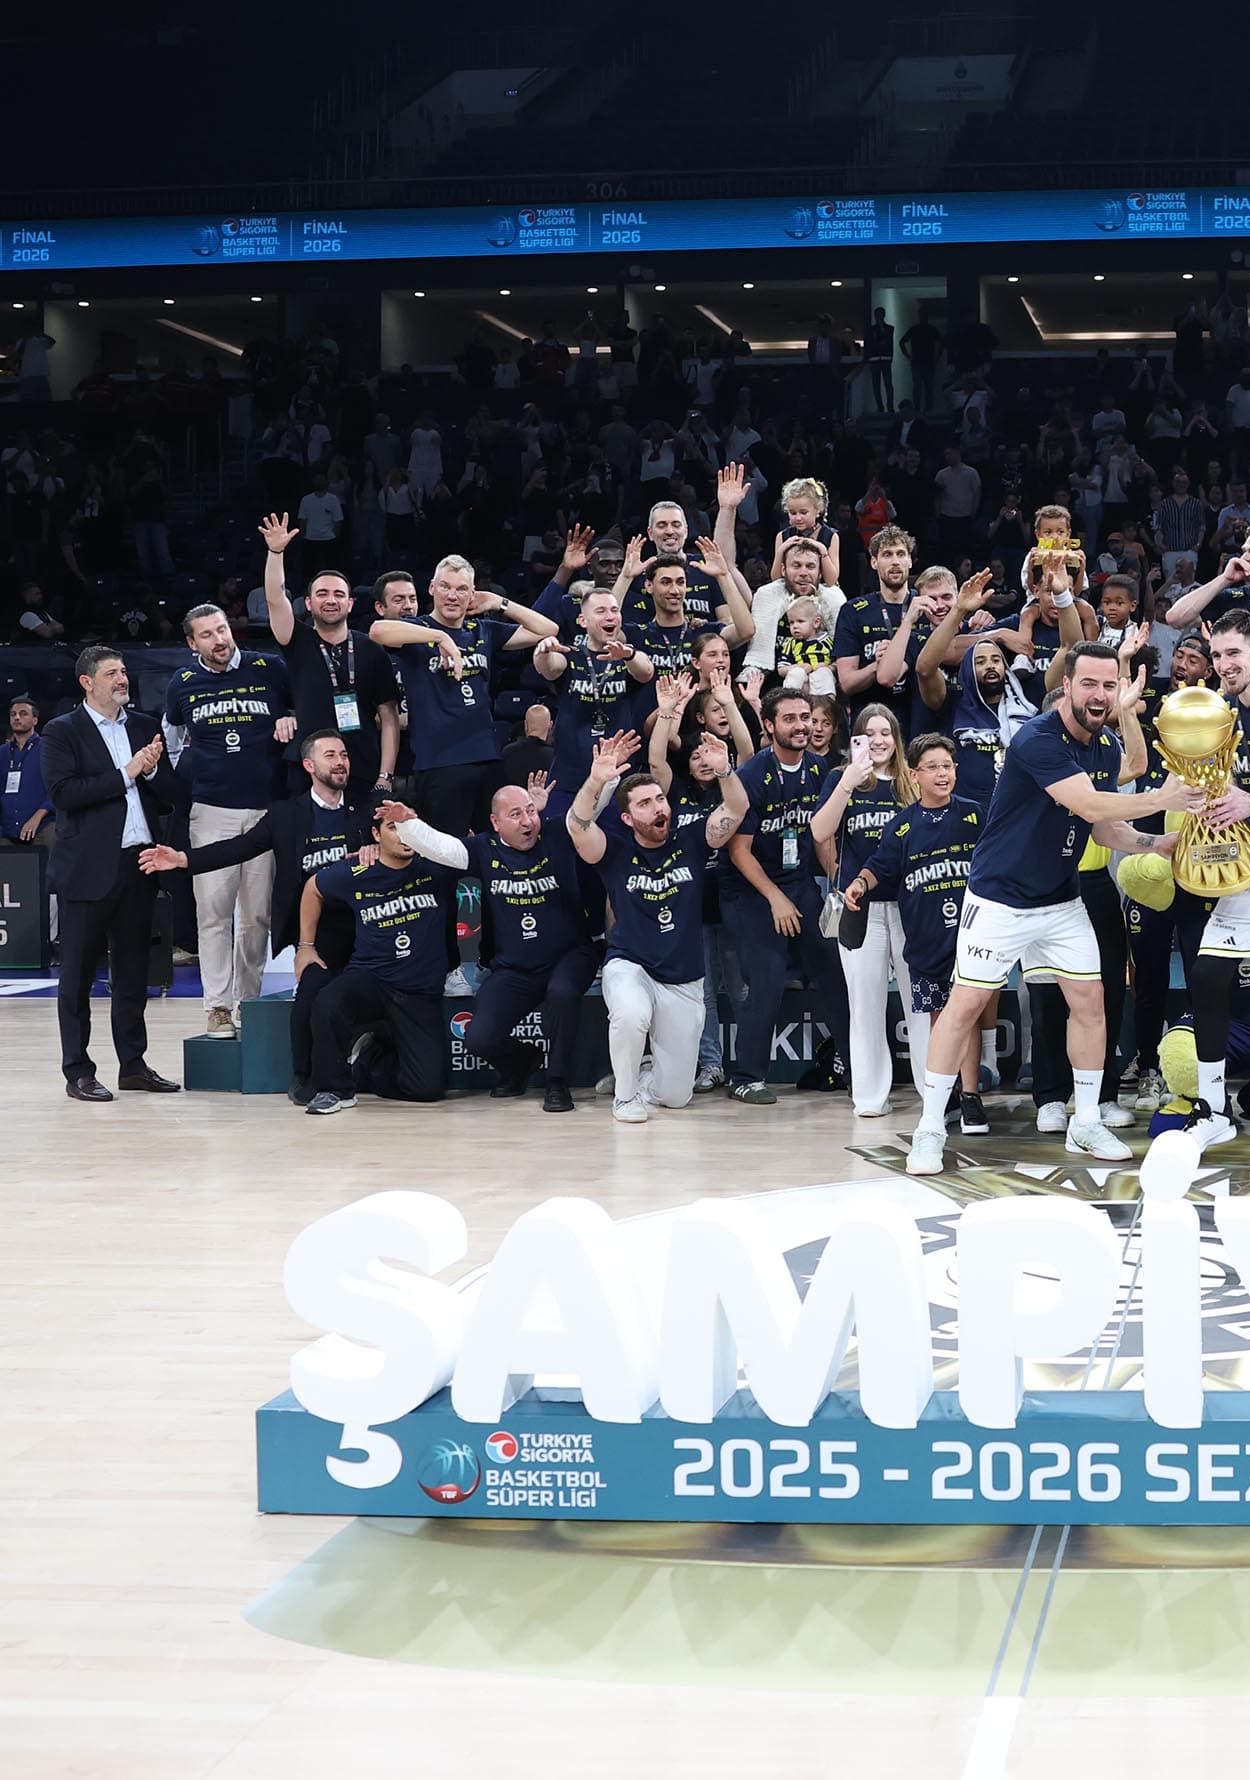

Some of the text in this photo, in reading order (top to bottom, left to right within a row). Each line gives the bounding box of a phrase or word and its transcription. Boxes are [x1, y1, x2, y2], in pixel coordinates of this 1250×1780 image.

[902, 202, 948, 217] FİNAL
[602, 210, 647, 226] FİNAL
[817, 220, 879, 230] BASKETBOL
[1128, 213, 1190, 222] BASKETBOL
[303, 220, 347, 235] FİNAL
[519, 228, 578, 238] BASKETBOL
[902, 222, 942, 236] 2026
[13, 228, 55, 243] FİNAL
[222, 237, 280, 247] BASKETBOL
[602, 230, 640, 244] 2026
[304, 238, 342, 252] 2026
[13, 248, 50, 262] 2026
[192, 698, 271, 723] ŞAMPİYON
[302, 844, 348, 872] ŞAMPİ
[905, 857, 971, 892] ŞAMPİYO
[490, 876, 560, 896] ŞAMPİYON
[360, 893, 438, 924] ŞAMPİYON
[966, 944, 992, 960] YKT
[673, 1438, 860, 1499] 2025
[930, 1440, 1121, 1502] 2026
[485, 1470, 607, 1488] BASKETBOL
[486, 1487, 596, 1508] SÜPER LİGİ
